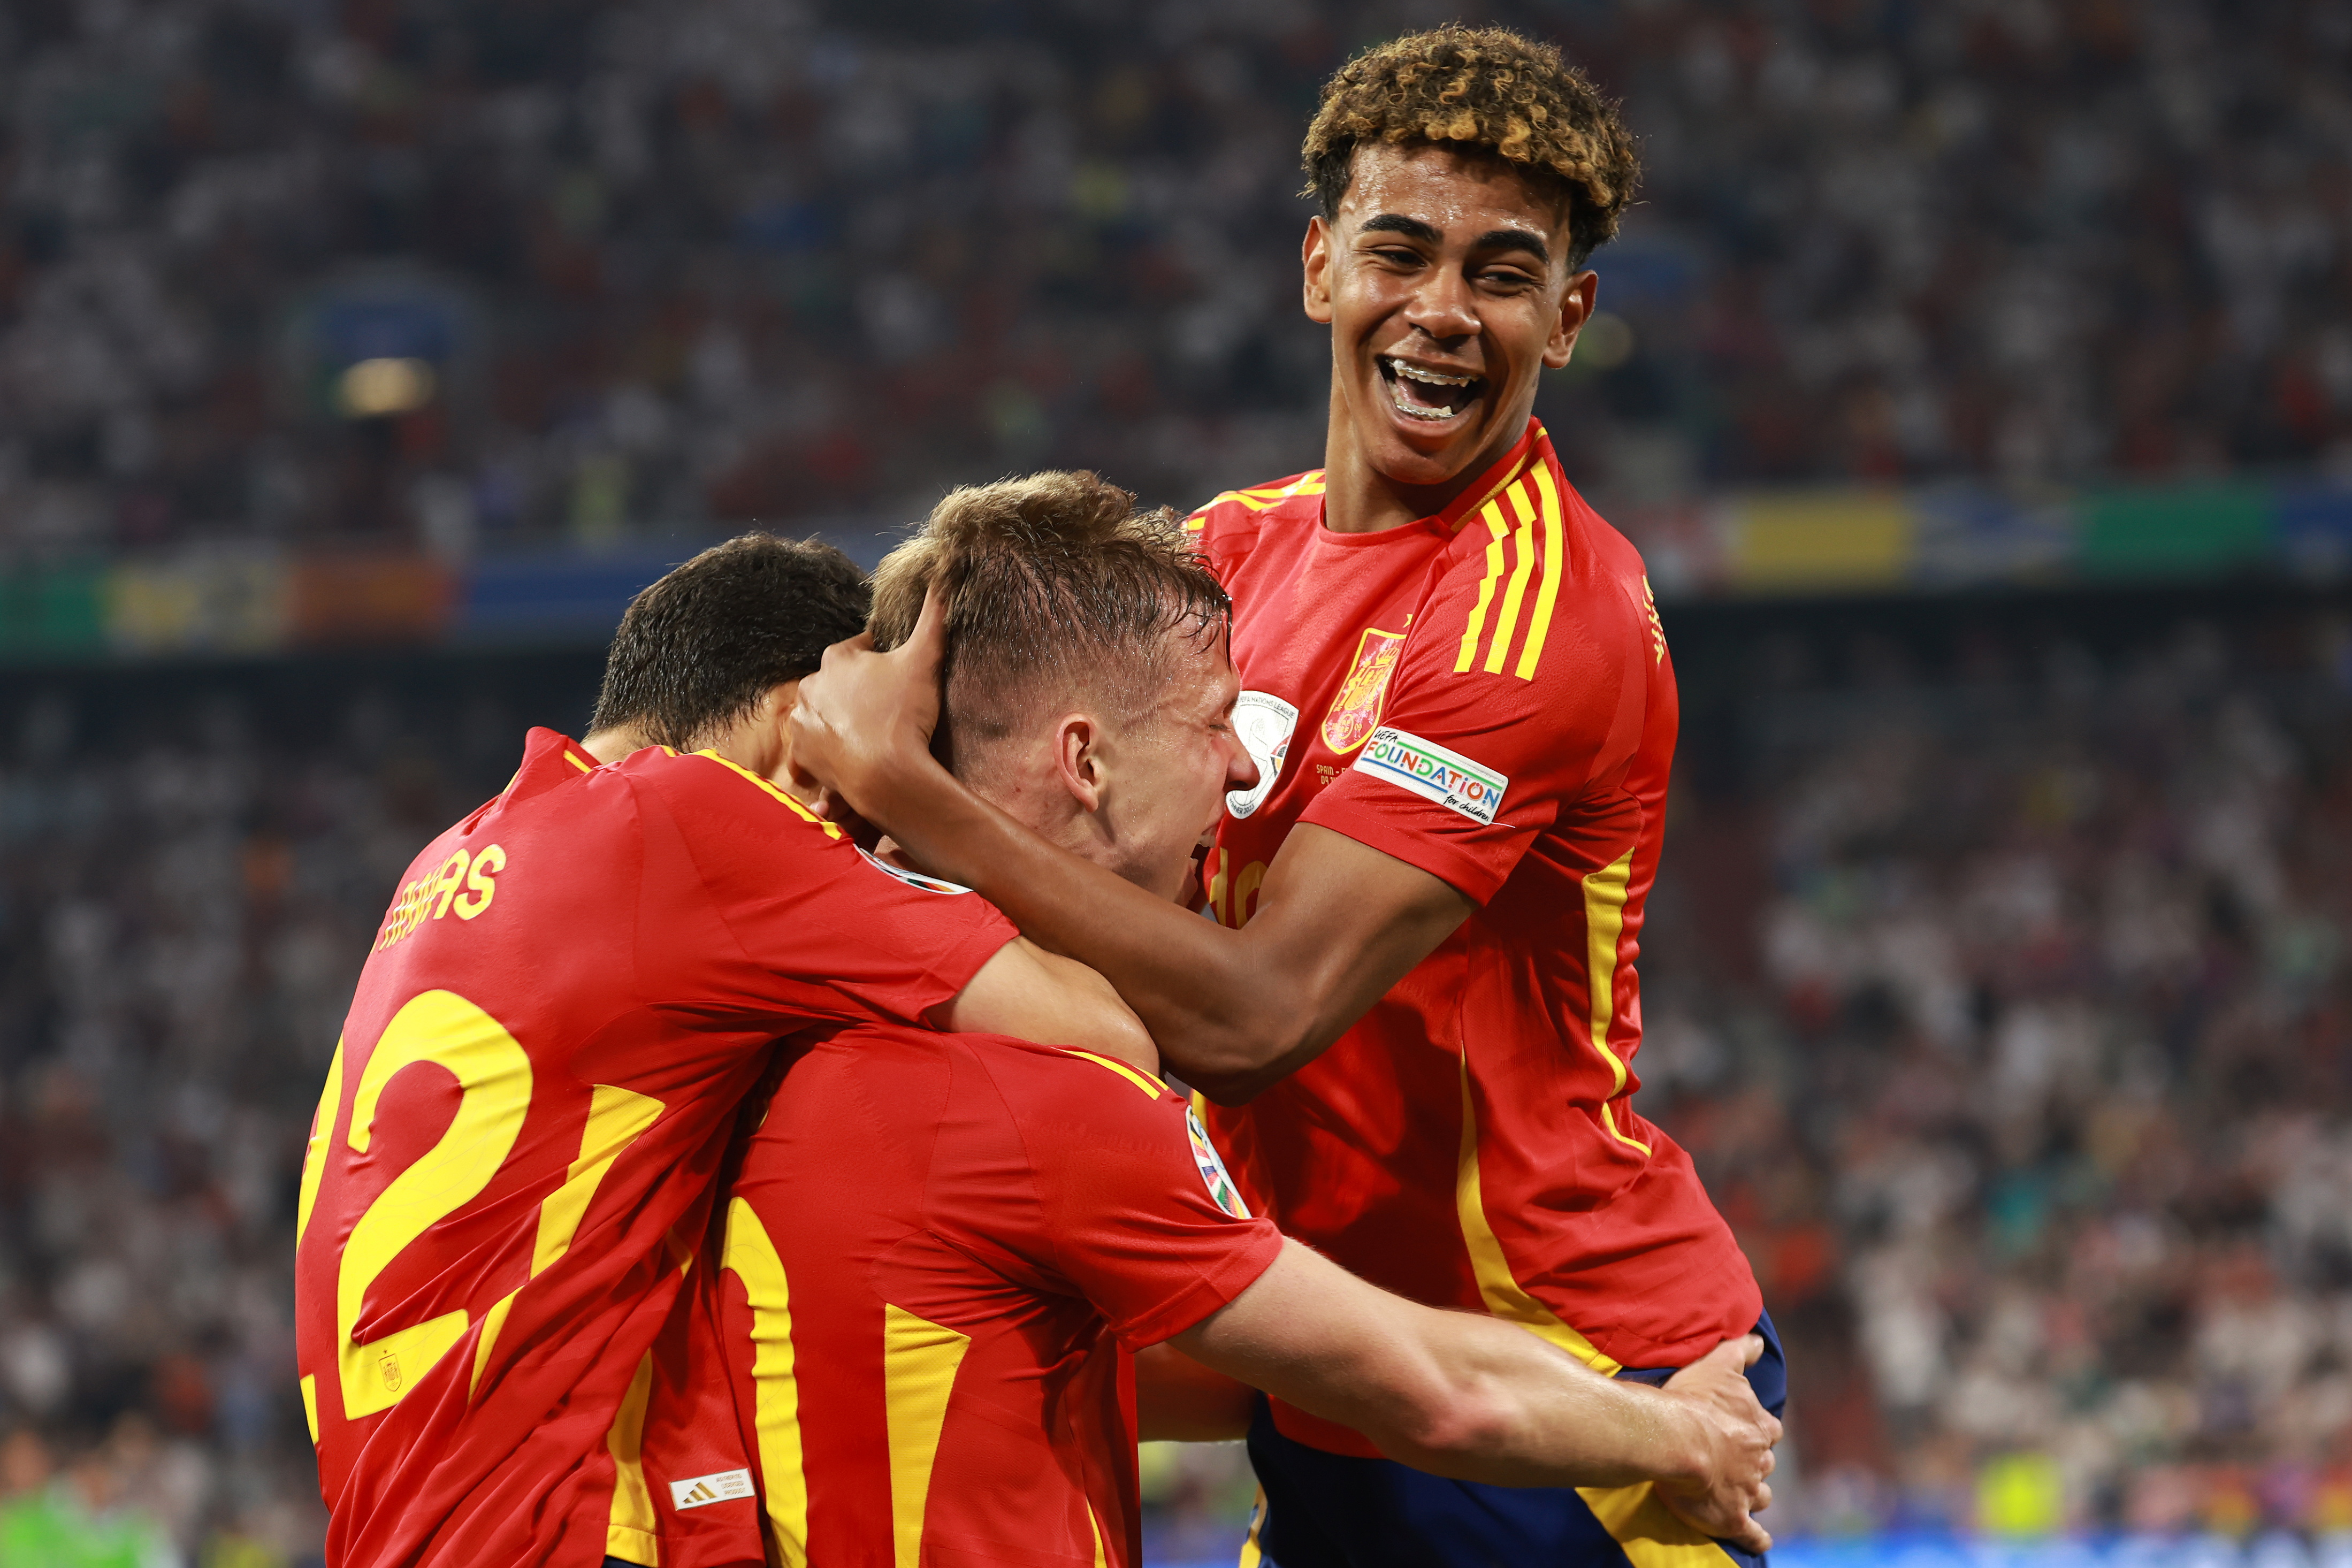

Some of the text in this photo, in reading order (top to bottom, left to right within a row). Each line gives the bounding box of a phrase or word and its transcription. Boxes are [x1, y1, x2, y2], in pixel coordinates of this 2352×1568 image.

[1274, 702, 1295, 718] LEAGUE
[1374, 730, 1399, 743] UEFA
[1316, 764, 1334, 776] SPAIN
[1443, 794, 1490, 821] for children
